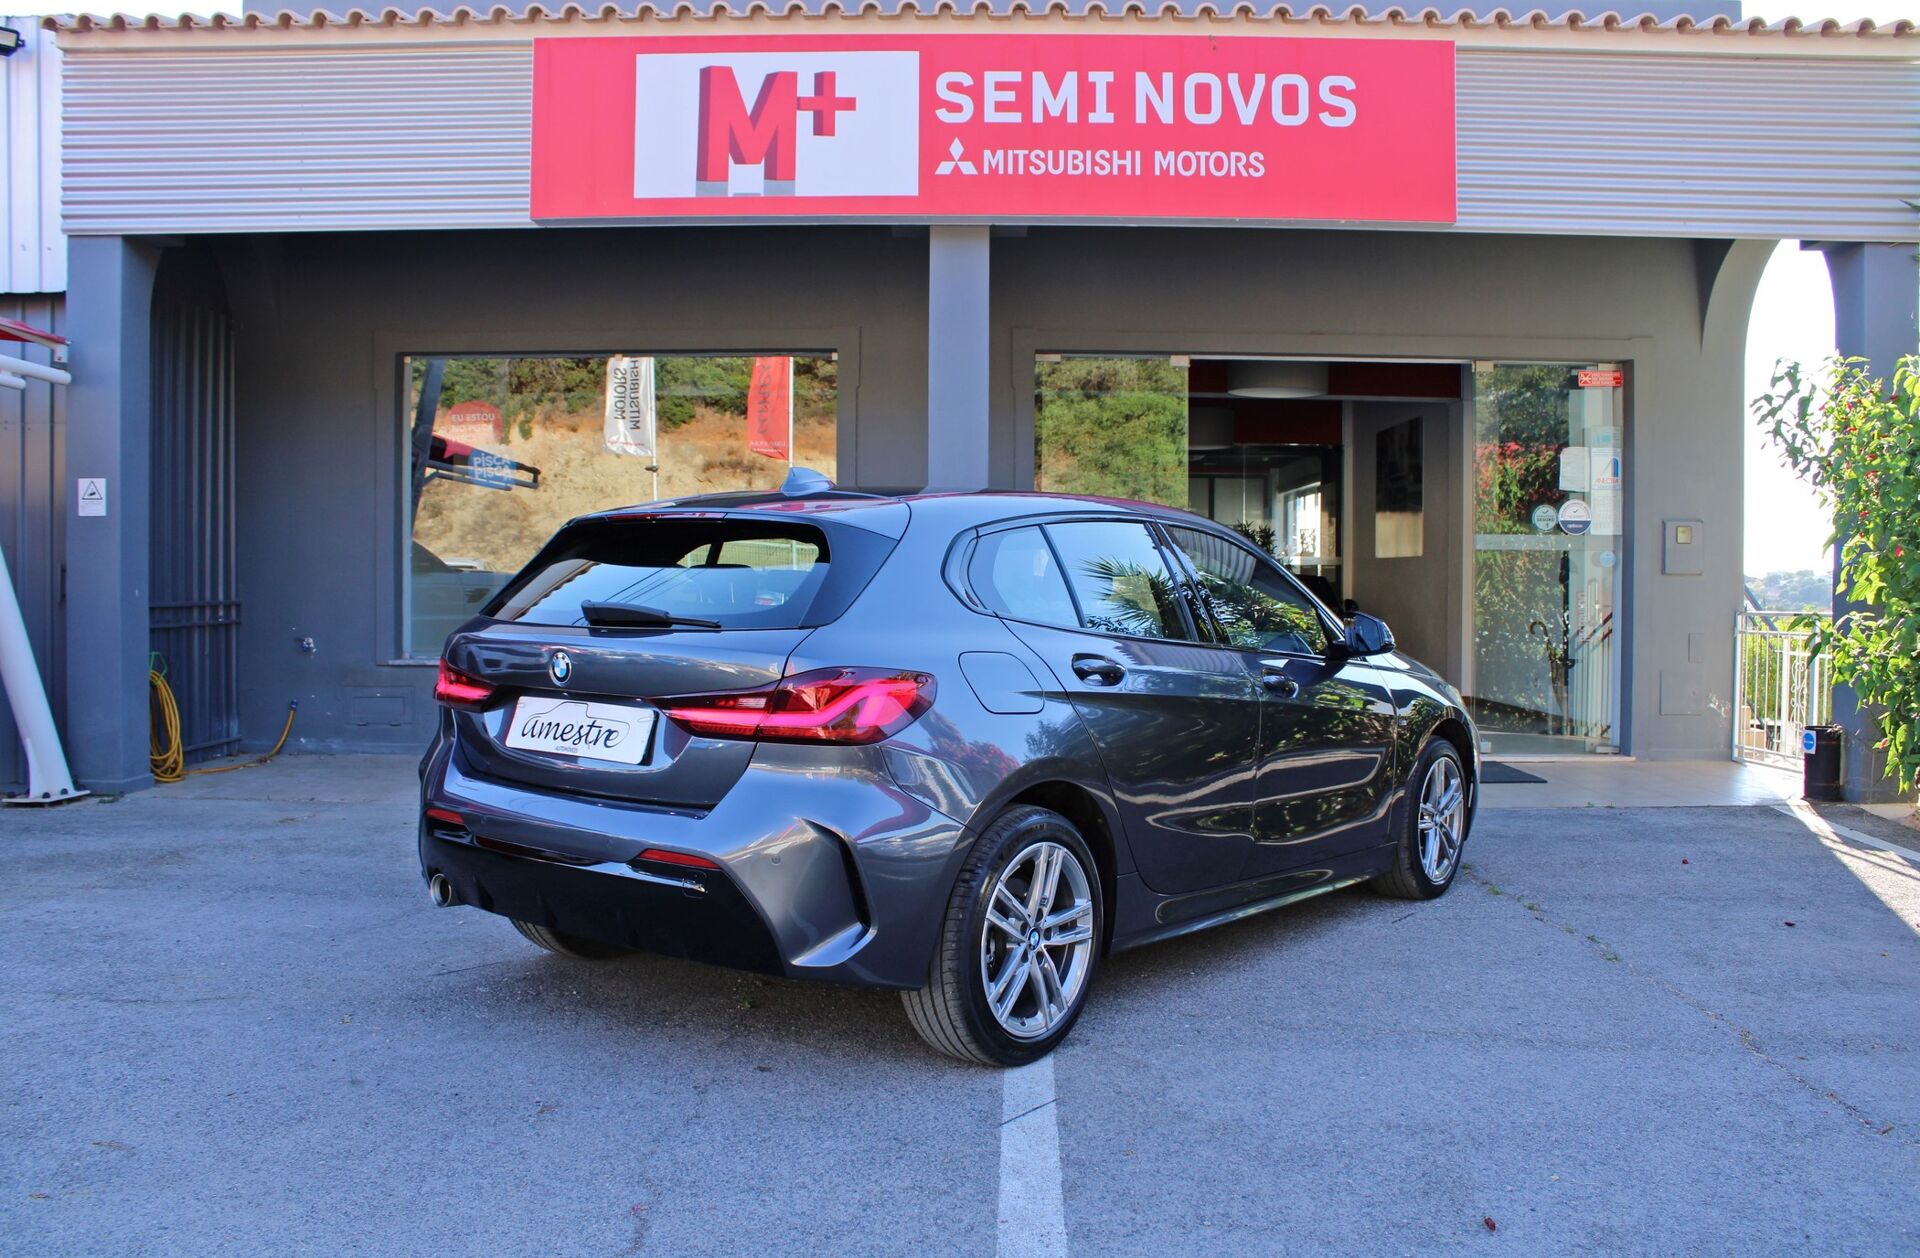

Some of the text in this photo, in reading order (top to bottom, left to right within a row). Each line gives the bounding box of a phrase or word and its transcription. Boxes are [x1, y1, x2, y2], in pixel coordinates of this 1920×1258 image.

[935, 71, 1358, 128] SEMI NOVOS
[696, 65, 856, 182] M+
[983, 149, 1266, 178] MITSUBISHI MOTORS
[521, 716, 620, 749] amestre
